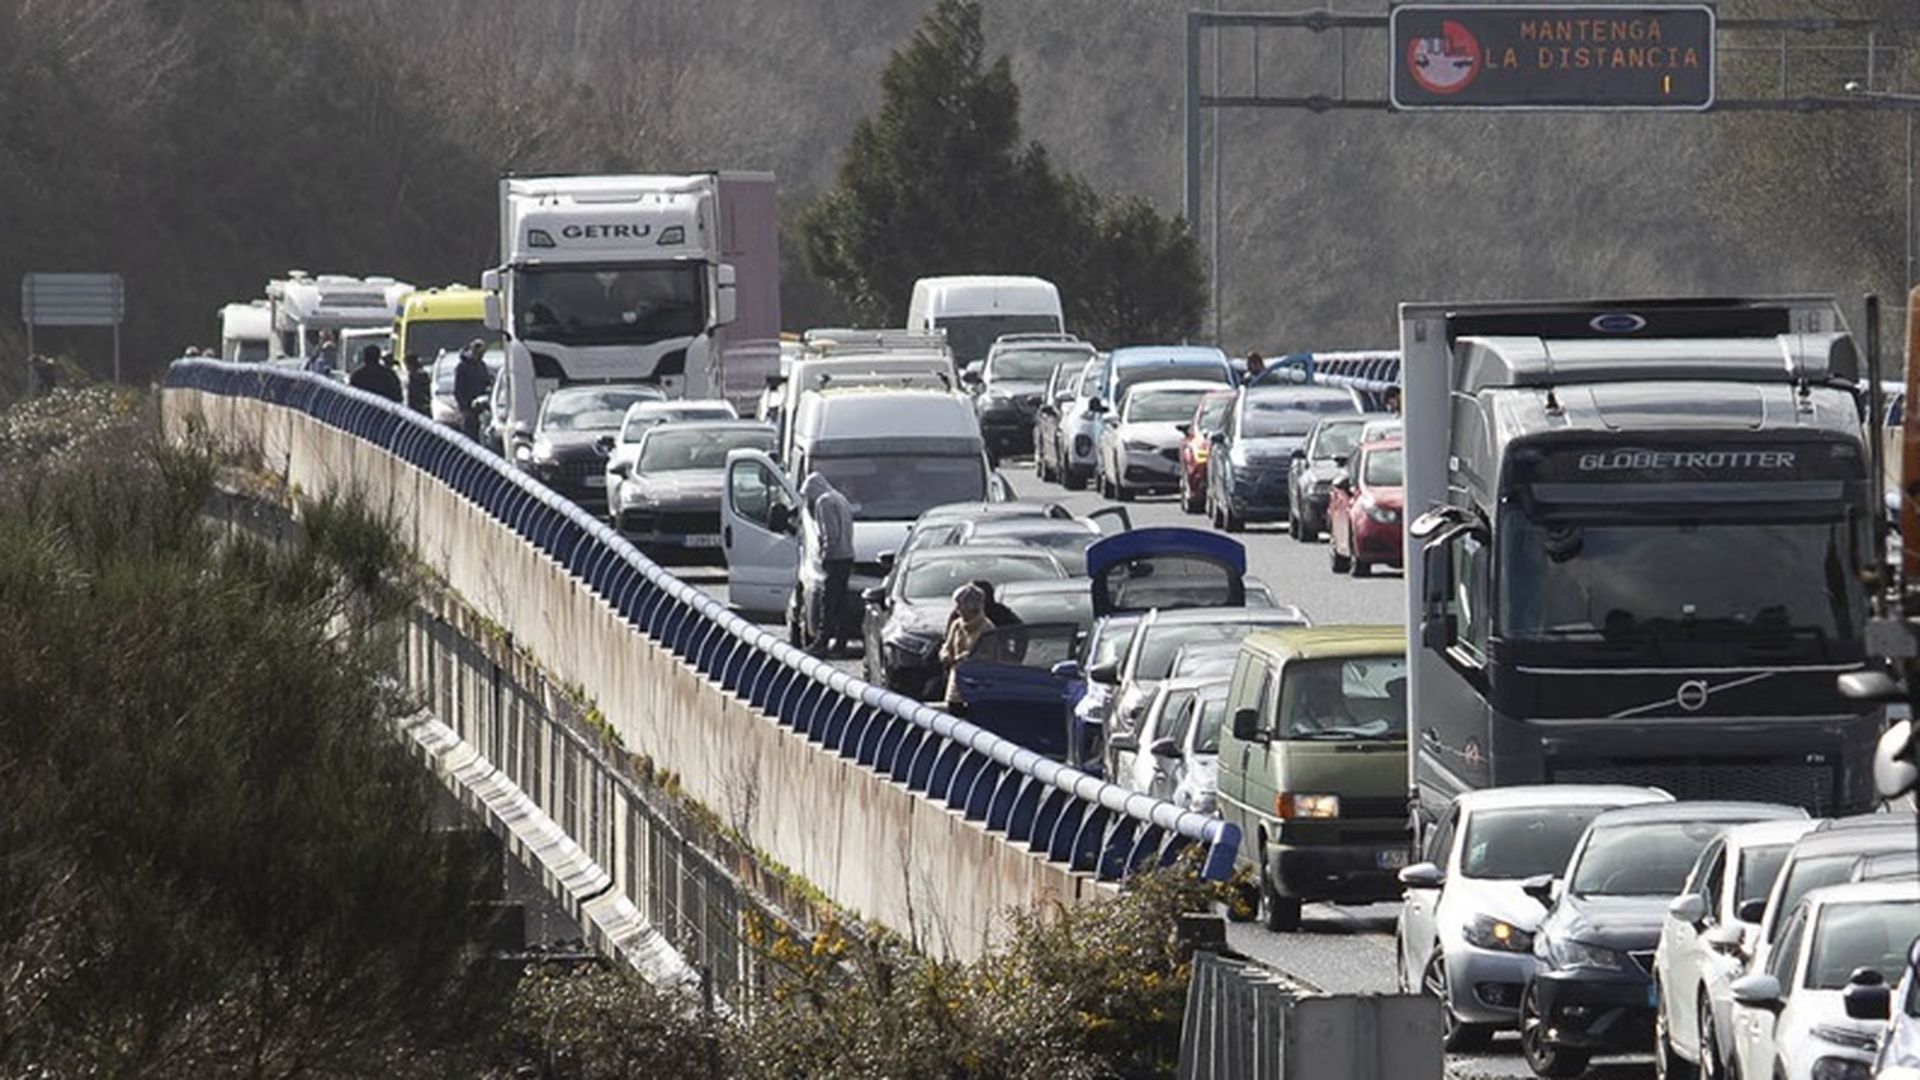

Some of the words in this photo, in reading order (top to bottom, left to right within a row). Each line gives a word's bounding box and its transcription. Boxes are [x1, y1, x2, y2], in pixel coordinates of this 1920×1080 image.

[1520, 20, 1661, 40] MANTENGA
[1486, 49, 1517, 68] LA
[1539, 49, 1698, 68] DISTANCIA
[562, 224, 651, 238] GETRU
[1579, 450, 1796, 471] GLOBETROTTER
